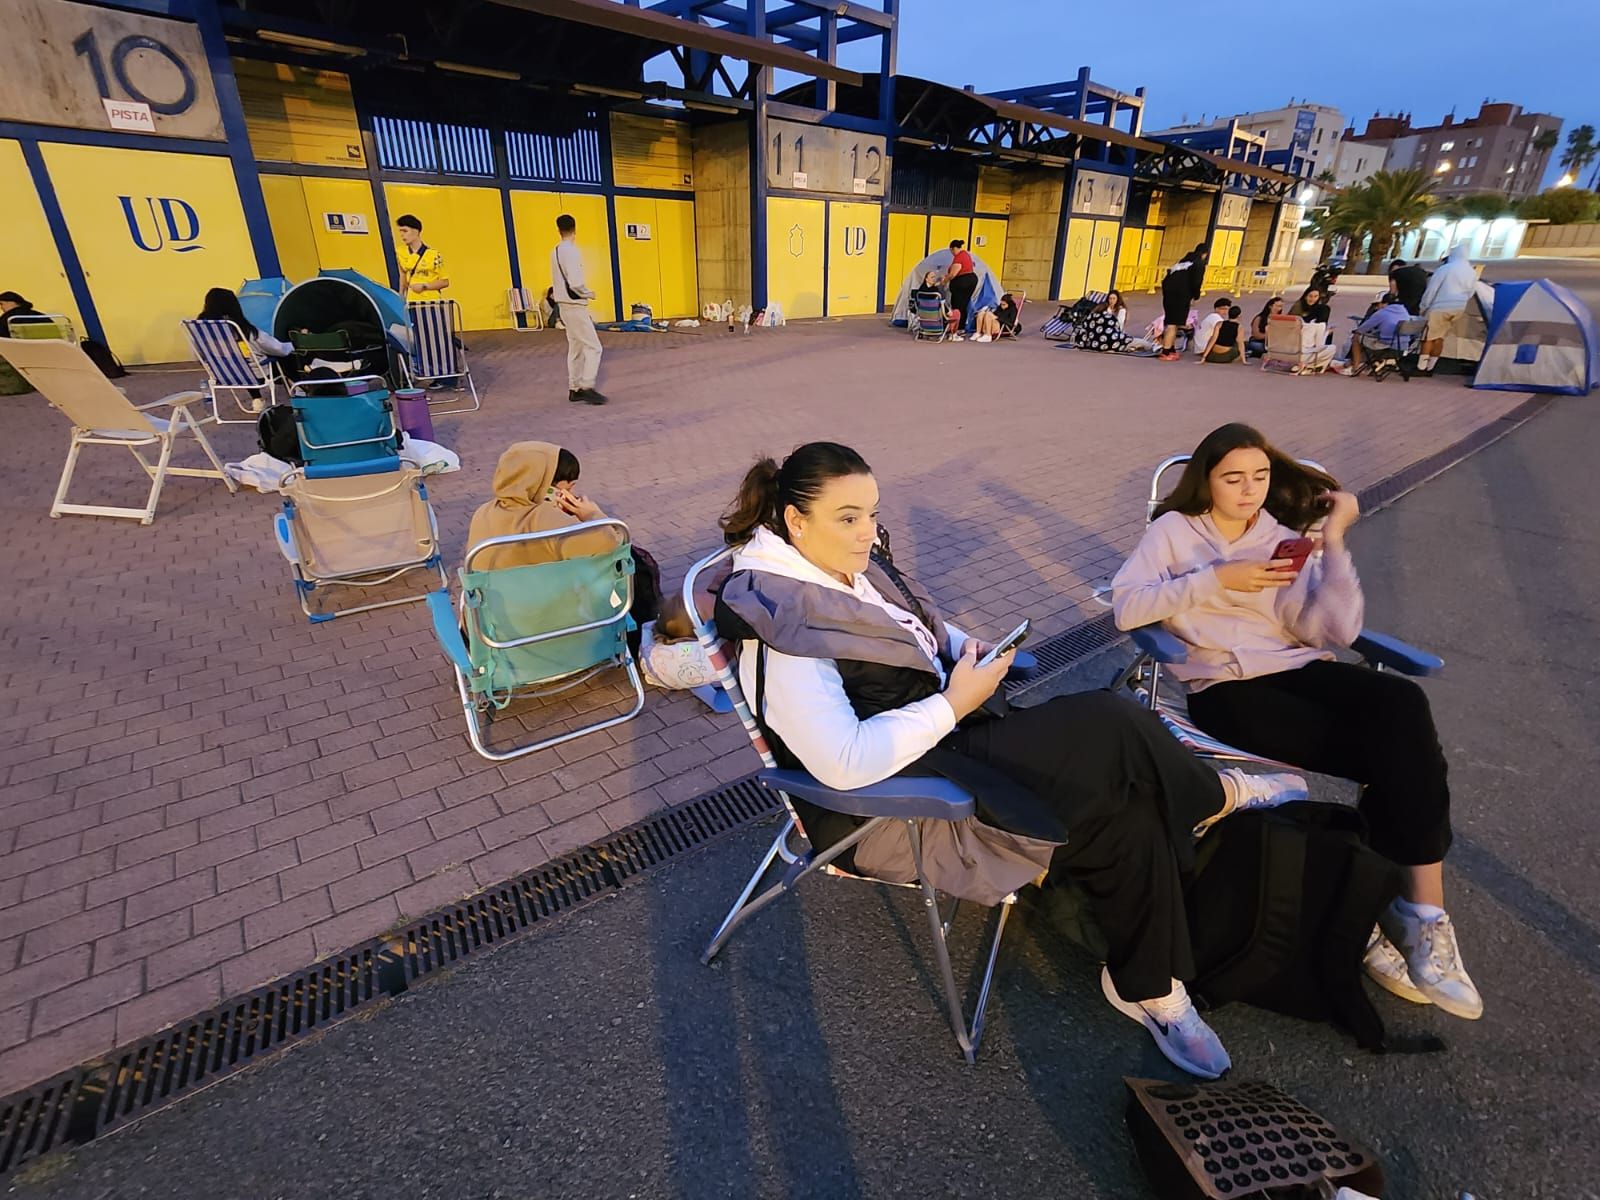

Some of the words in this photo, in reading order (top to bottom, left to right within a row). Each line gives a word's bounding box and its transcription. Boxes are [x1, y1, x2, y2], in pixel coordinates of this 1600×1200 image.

[72, 27, 196, 116] 10
[111, 108, 149, 122] PISTA
[772, 131, 804, 176] 11
[851, 142, 881, 184] 12
[1077, 177, 1095, 205] 13
[1108, 184, 1125, 207] 14
[117, 195, 206, 252] UD
[845, 227, 866, 256] UD
